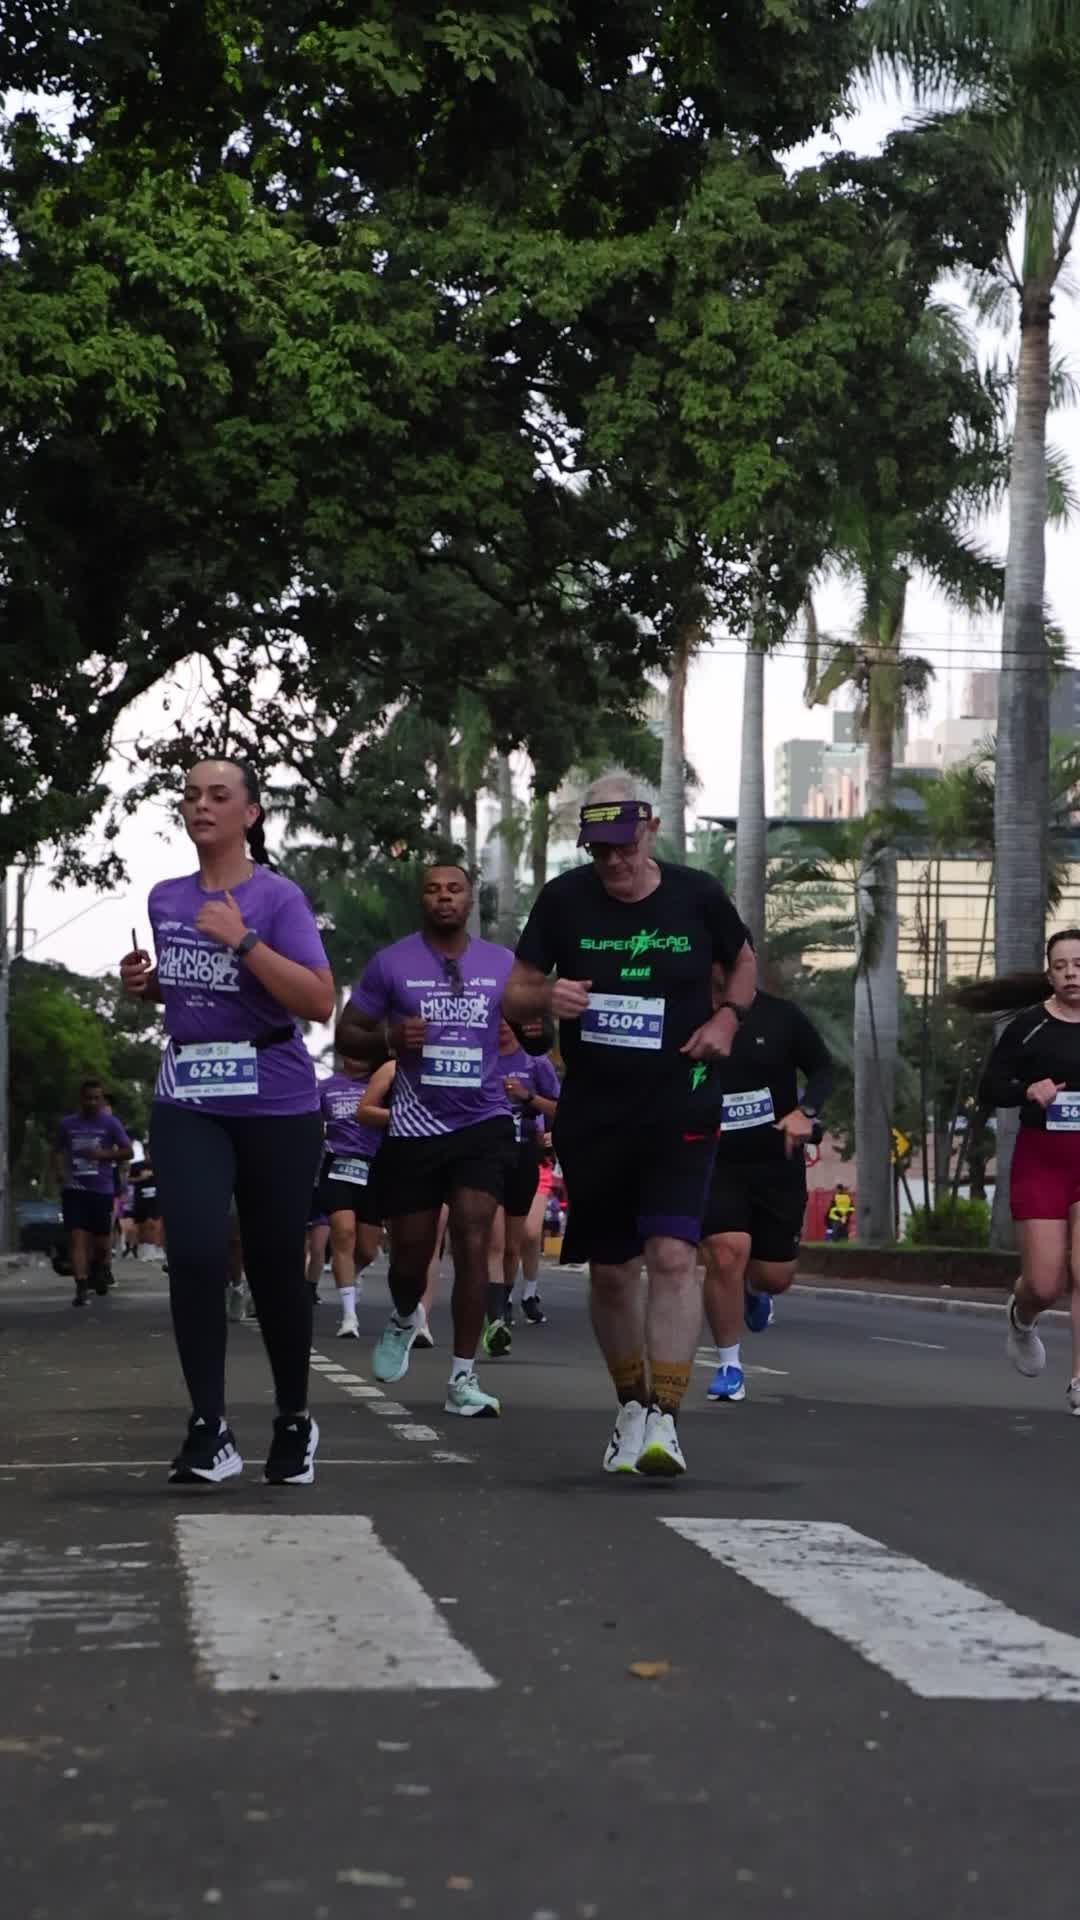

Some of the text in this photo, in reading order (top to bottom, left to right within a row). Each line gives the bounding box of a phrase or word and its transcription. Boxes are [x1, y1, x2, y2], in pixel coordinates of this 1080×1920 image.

[160, 946, 225, 967] MUNDO
[419, 997, 481, 1010] MUNDO
[597, 1013, 645, 1030] 5604
[189, 1060, 238, 1078] 6242
[434, 1060, 471, 1073] 5130
[727, 1102, 762, 1118] 6032
[1060, 1105, 1079, 1118] 56
